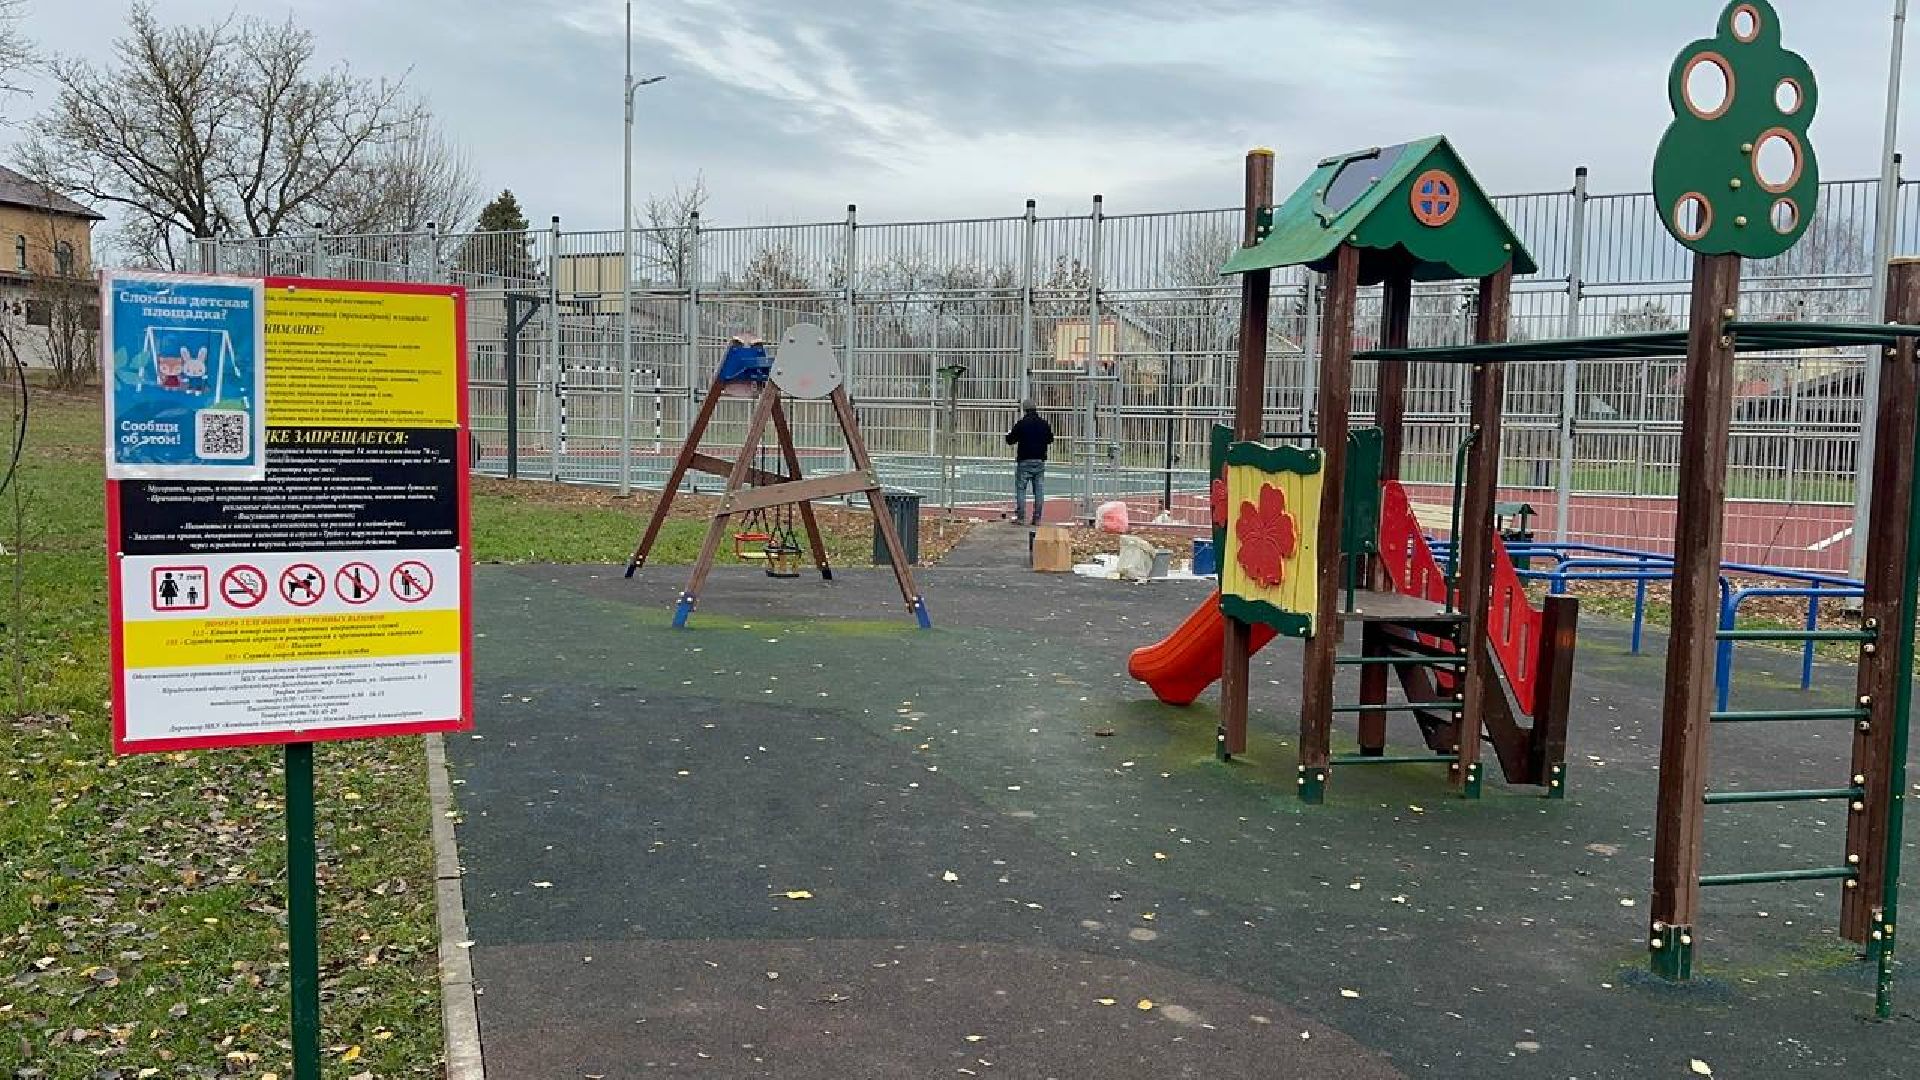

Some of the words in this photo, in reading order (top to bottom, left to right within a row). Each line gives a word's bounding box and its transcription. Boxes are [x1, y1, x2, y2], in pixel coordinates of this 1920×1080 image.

[119, 291, 187, 306] Сломана
[190, 297, 250, 309] детская
[143, 307, 229, 320] площадка?
[120, 420, 179, 433] Сообщи
[120, 432, 138, 444] об
[140, 433, 181, 446] этом!
[294, 430, 409, 444] ЗАПРЕЩАЕТСЯ:
